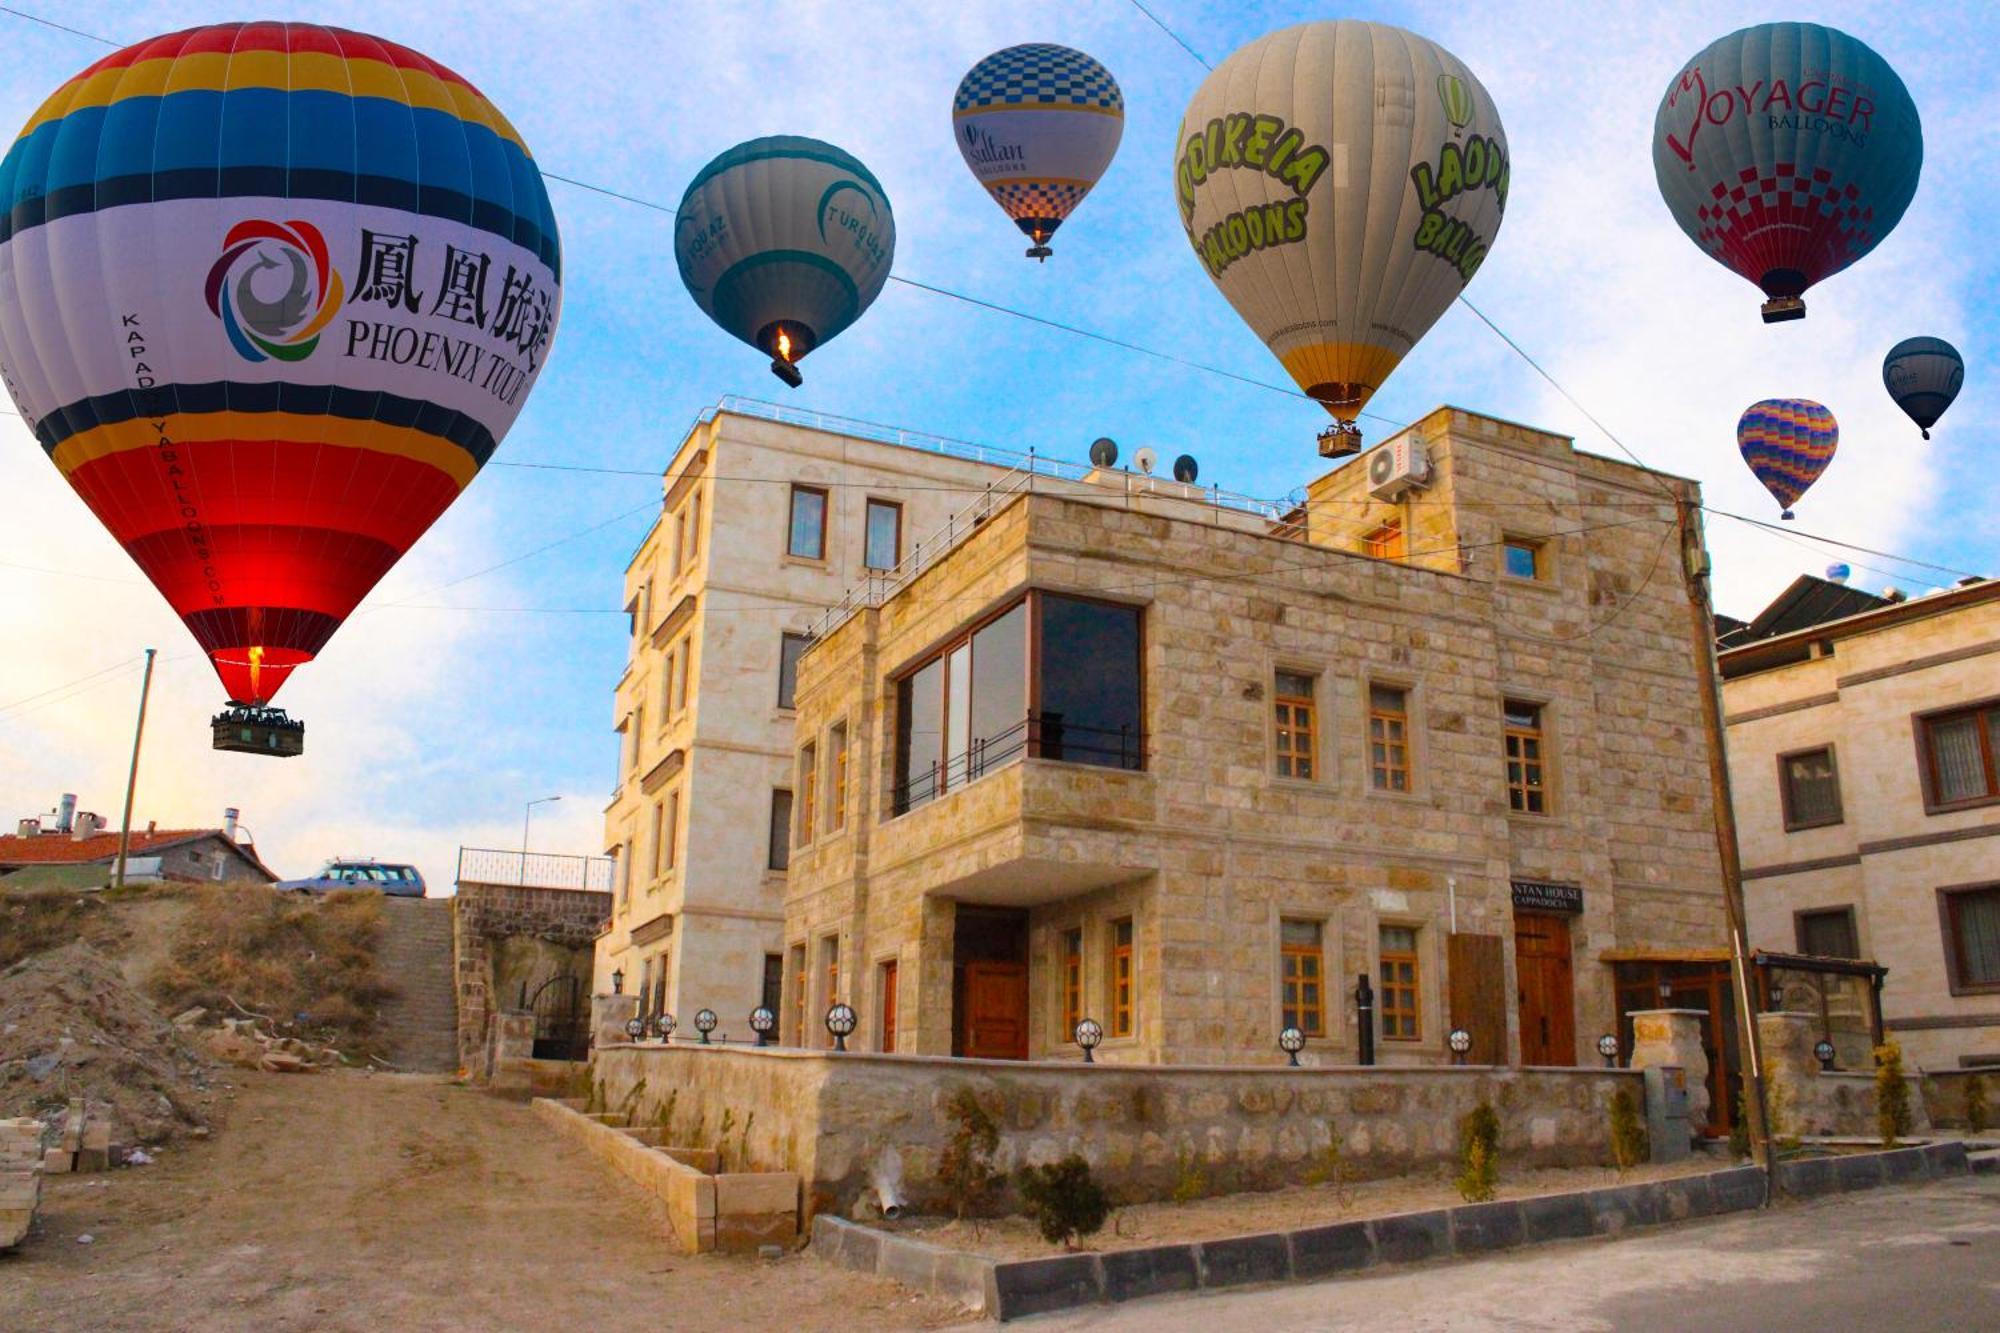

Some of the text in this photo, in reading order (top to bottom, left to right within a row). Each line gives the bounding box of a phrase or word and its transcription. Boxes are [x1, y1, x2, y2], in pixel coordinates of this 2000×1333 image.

[1768, 115, 1867, 150] BALLOONS
[828, 205, 885, 264] TURQUAZ
[1190, 197, 1310, 280] ALLOONS
[343, 319, 487, 384] PHOENIX
[1545, 886, 1578, 900] HOUSE
